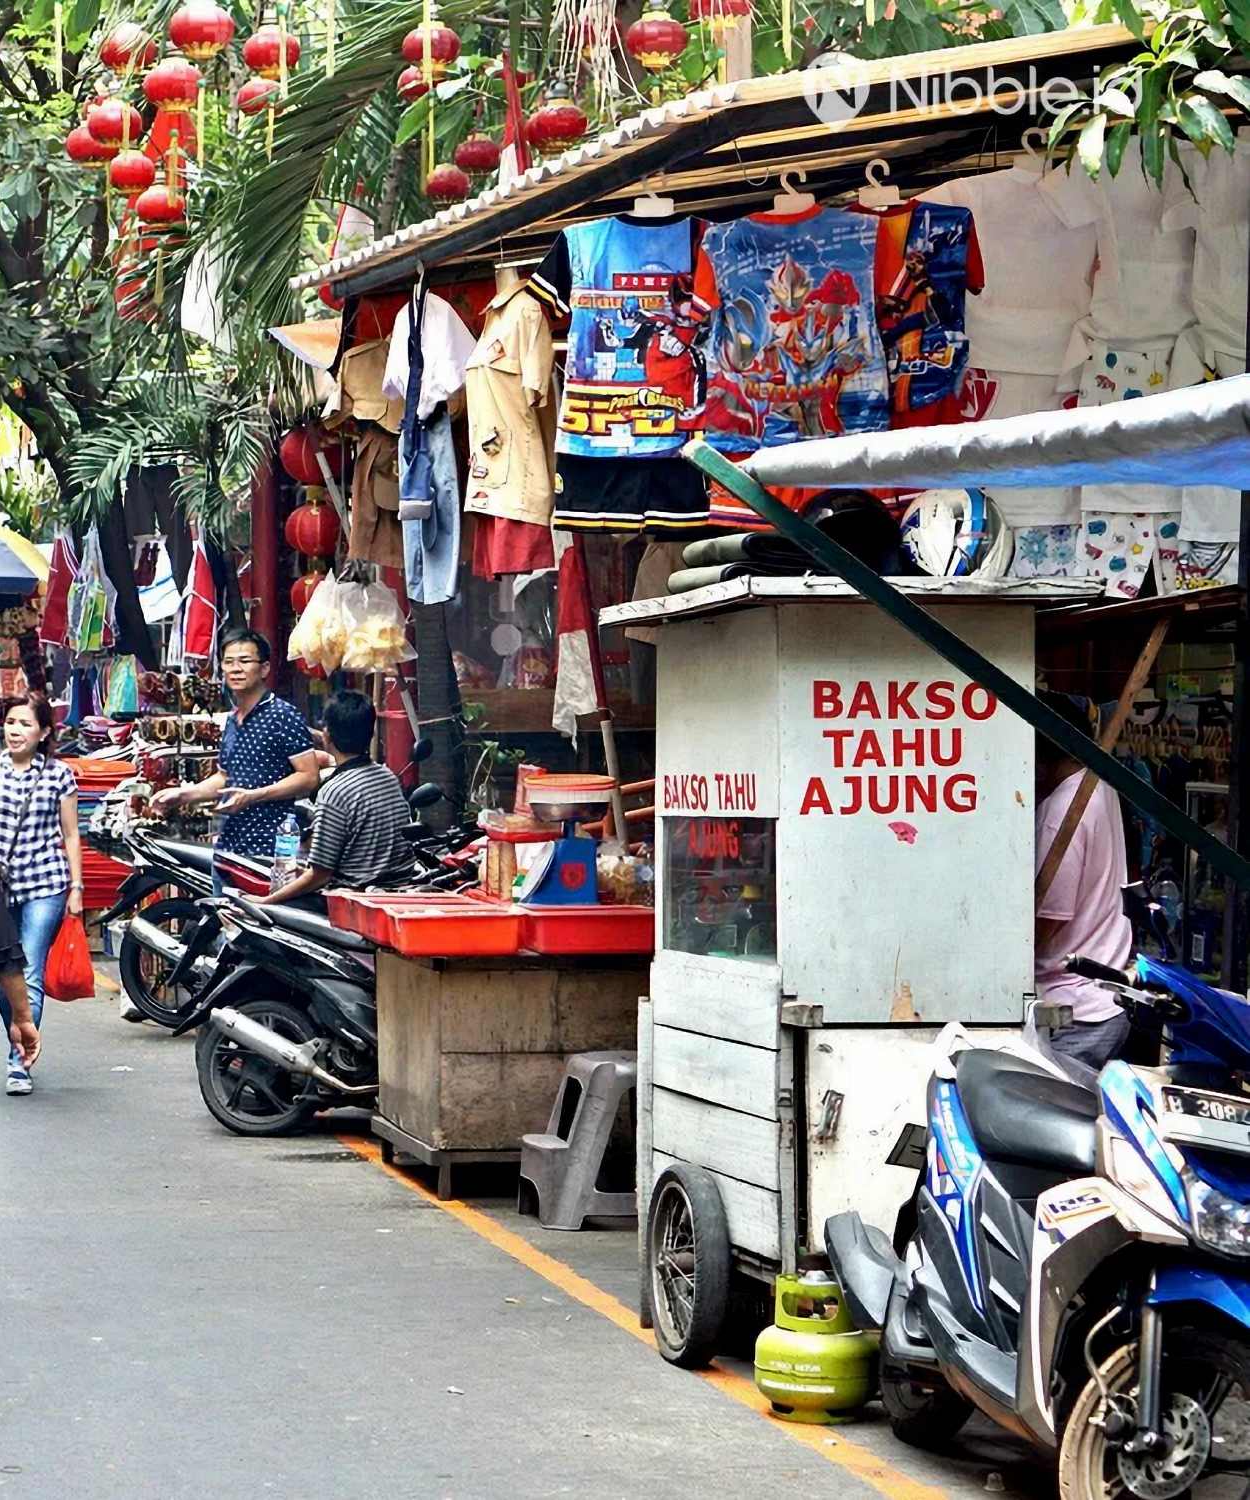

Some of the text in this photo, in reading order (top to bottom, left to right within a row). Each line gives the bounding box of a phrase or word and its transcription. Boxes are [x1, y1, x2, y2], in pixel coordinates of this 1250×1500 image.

[812, 680, 998, 721] BAKSO
[822, 728, 964, 768] TAHU
[664, 772, 757, 813] BAKSO TAHU
[799, 774, 978, 816] AJUNG
[688, 819, 740, 859] AJUNG
